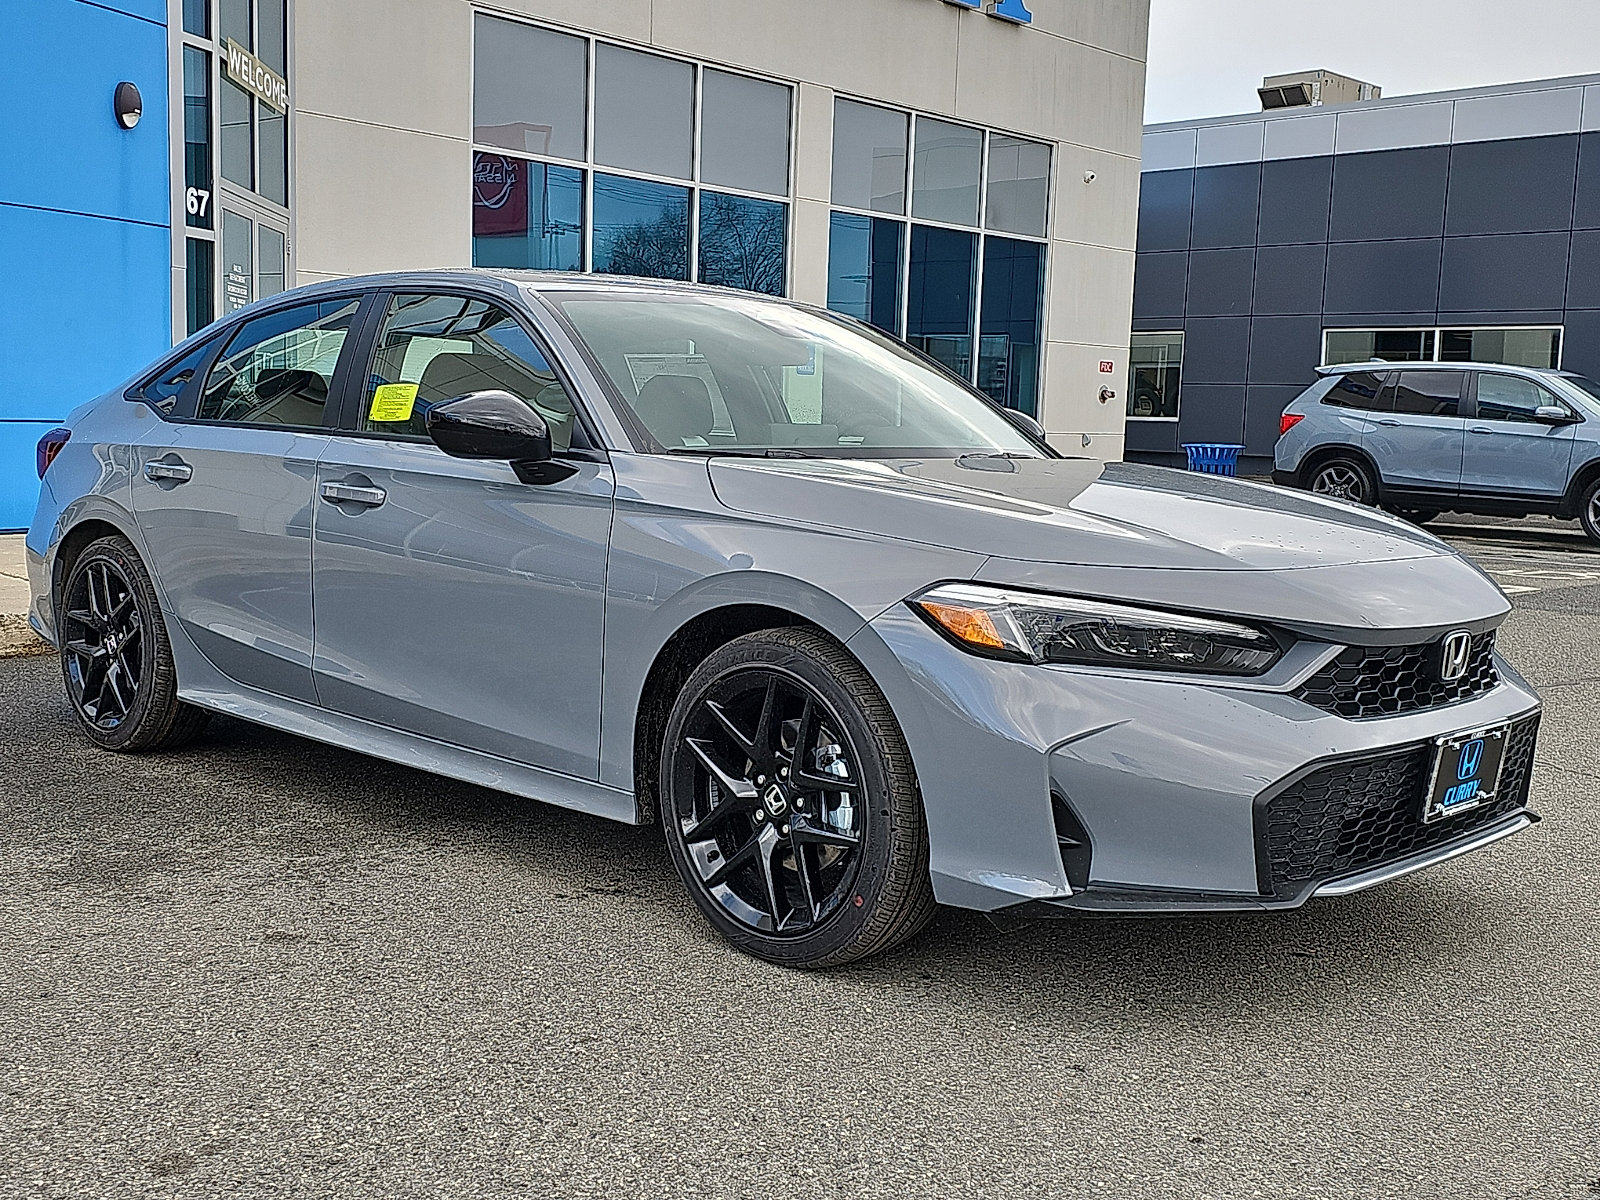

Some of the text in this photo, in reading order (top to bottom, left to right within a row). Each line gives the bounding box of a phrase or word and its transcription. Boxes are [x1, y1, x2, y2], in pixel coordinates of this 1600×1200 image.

[228, 43, 287, 109] WELCOME
[186, 186, 210, 217] 67
[1100, 362, 1112, 372] FDC
[1443, 778, 1482, 806] CURRY
